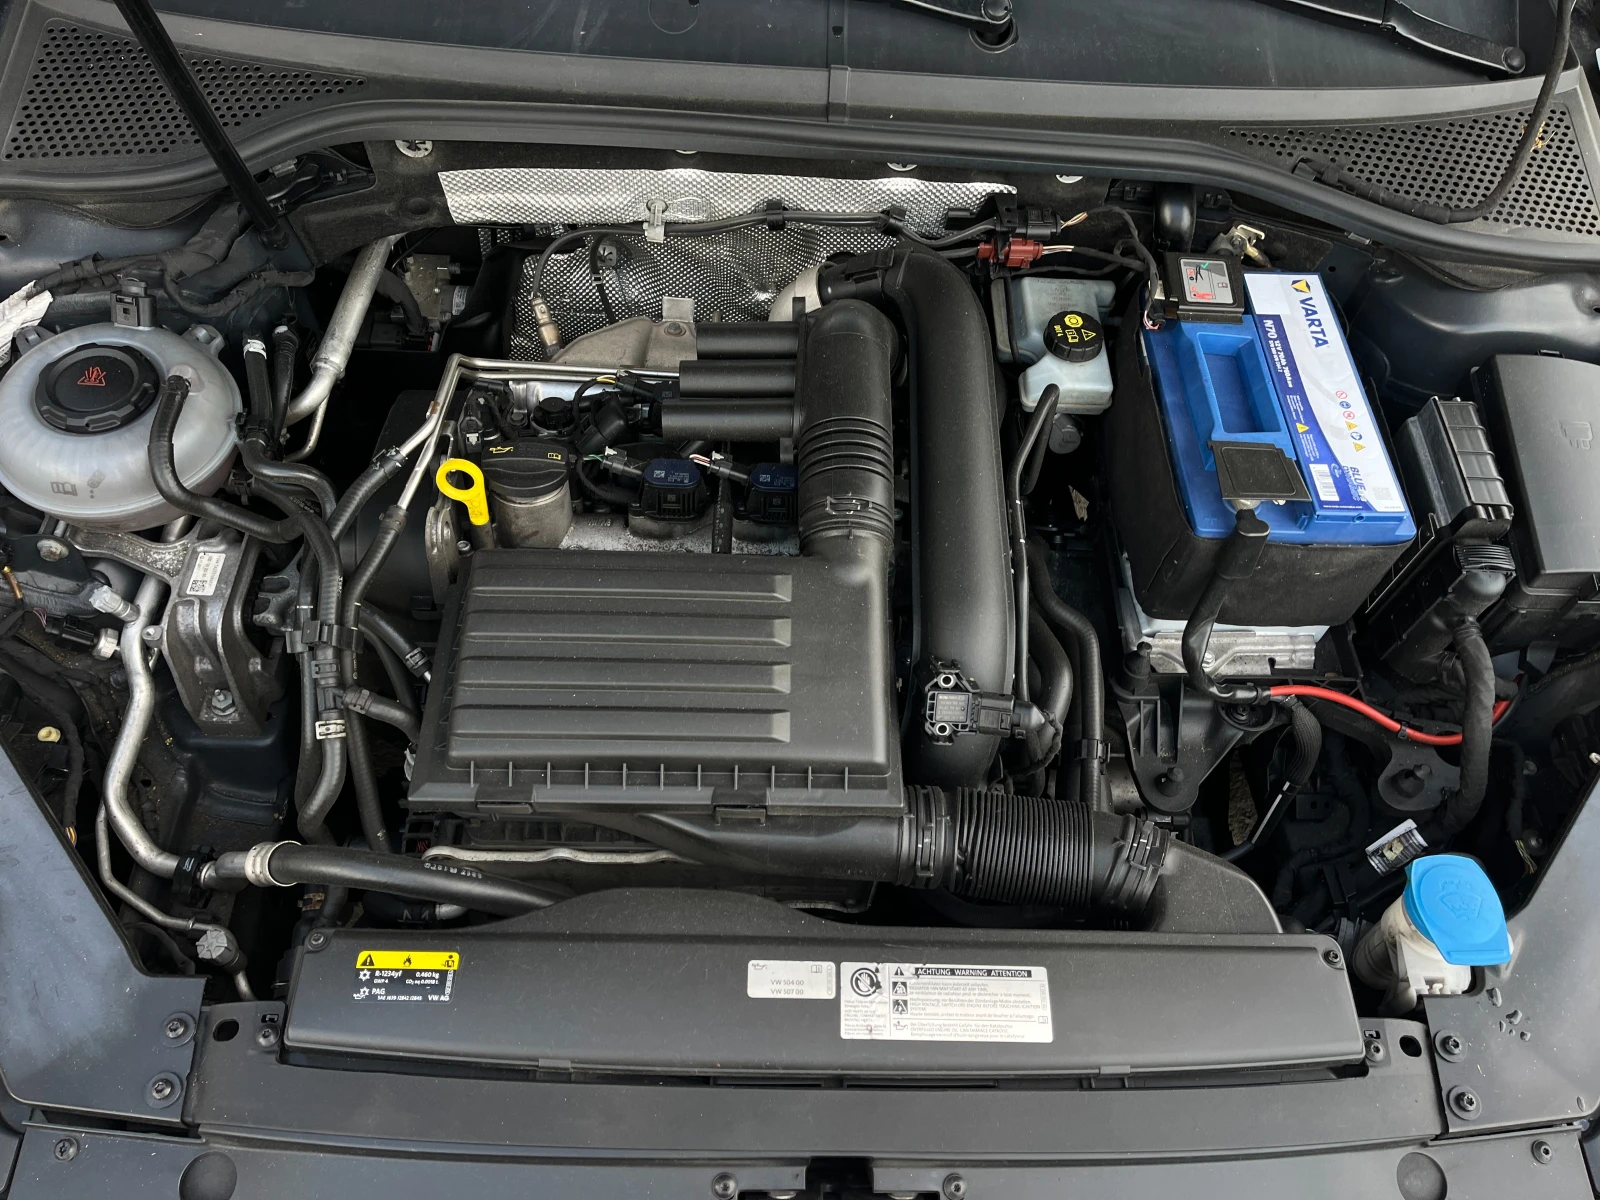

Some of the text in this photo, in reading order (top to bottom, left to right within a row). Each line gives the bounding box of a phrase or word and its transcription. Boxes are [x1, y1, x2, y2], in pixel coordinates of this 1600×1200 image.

[1263, 319, 1278, 338] N70
[1299, 296, 1328, 348] VARTA
[1350, 466, 1366, 490] BLUE
[375, 970, 402, 978] R-1234yf
